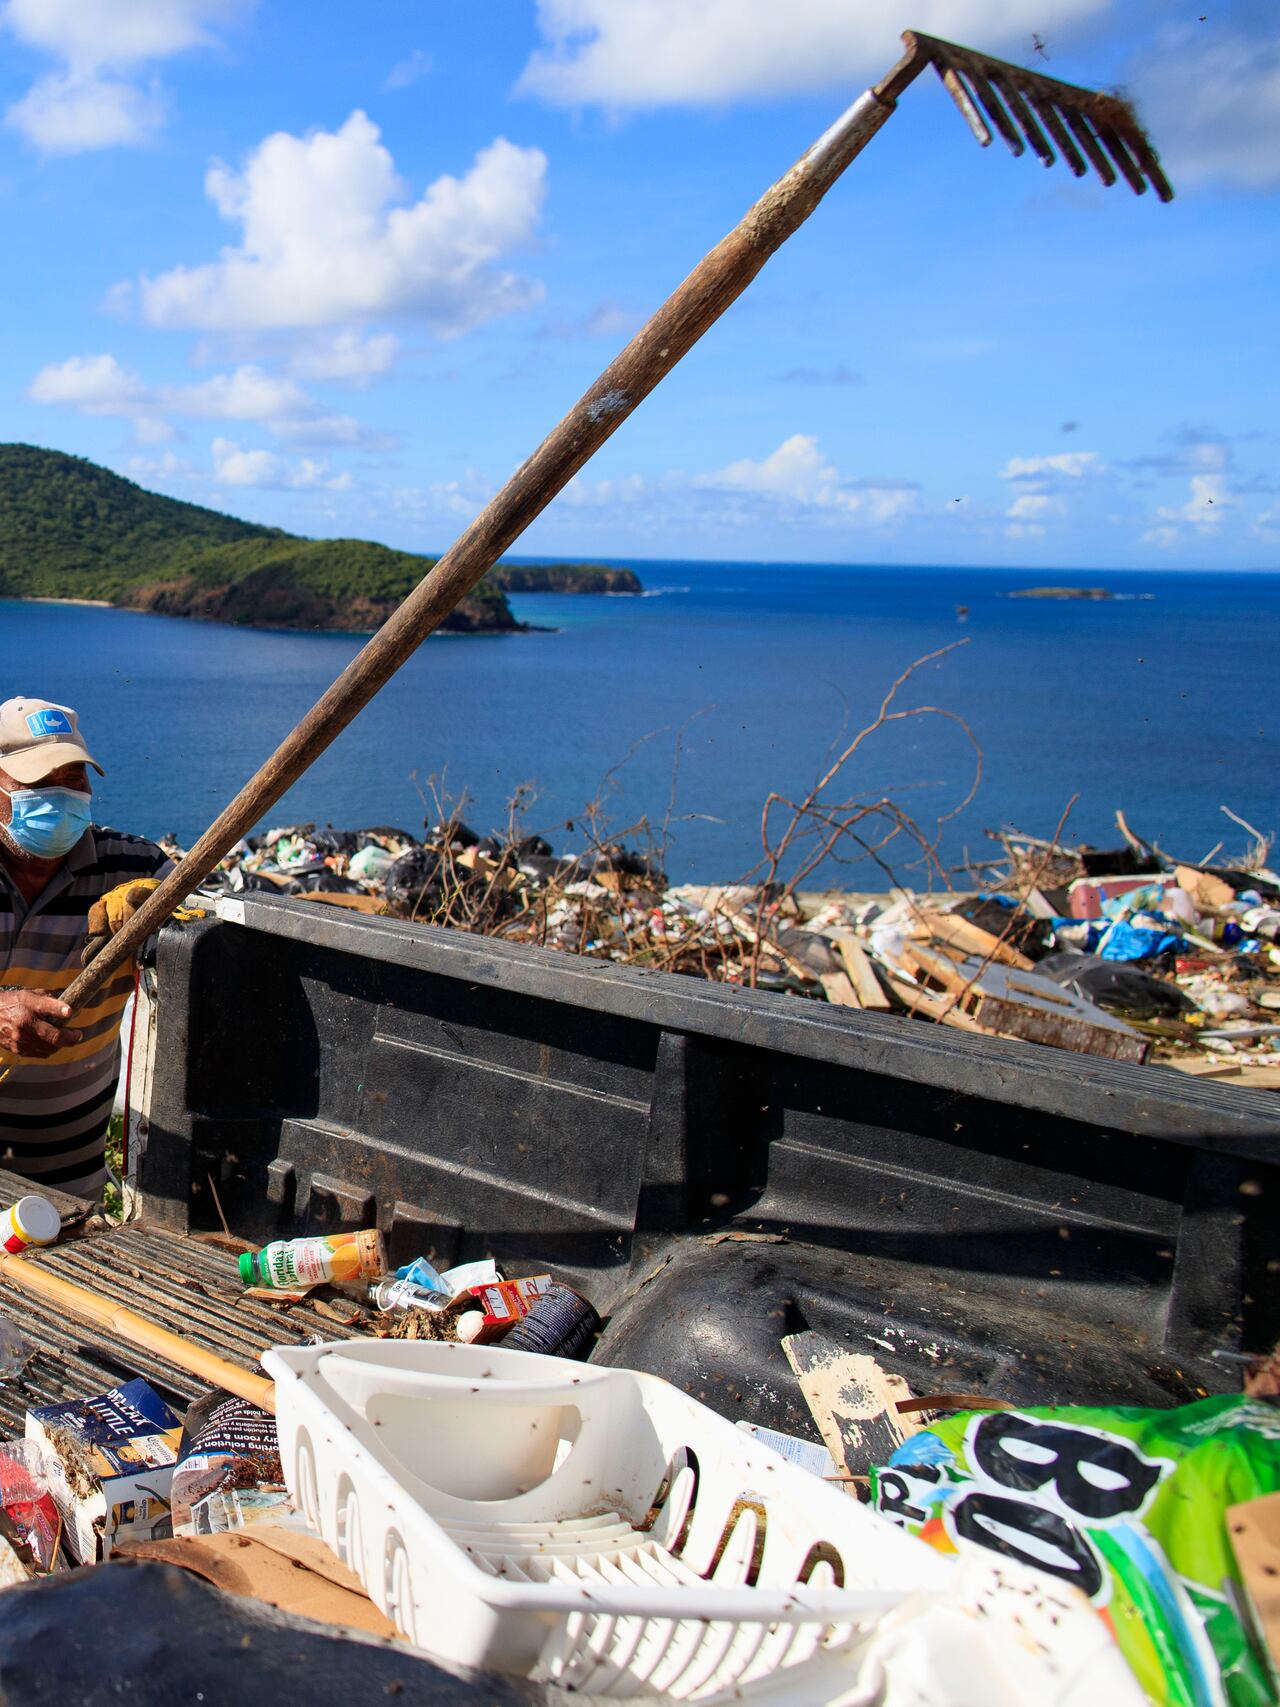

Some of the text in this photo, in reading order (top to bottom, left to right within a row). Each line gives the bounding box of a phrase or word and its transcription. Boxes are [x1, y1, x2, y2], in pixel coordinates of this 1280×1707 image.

[196, 1433, 221, 1445] more
[204, 1440, 246, 1448] solution
[247, 1441, 280, 1451] orting
